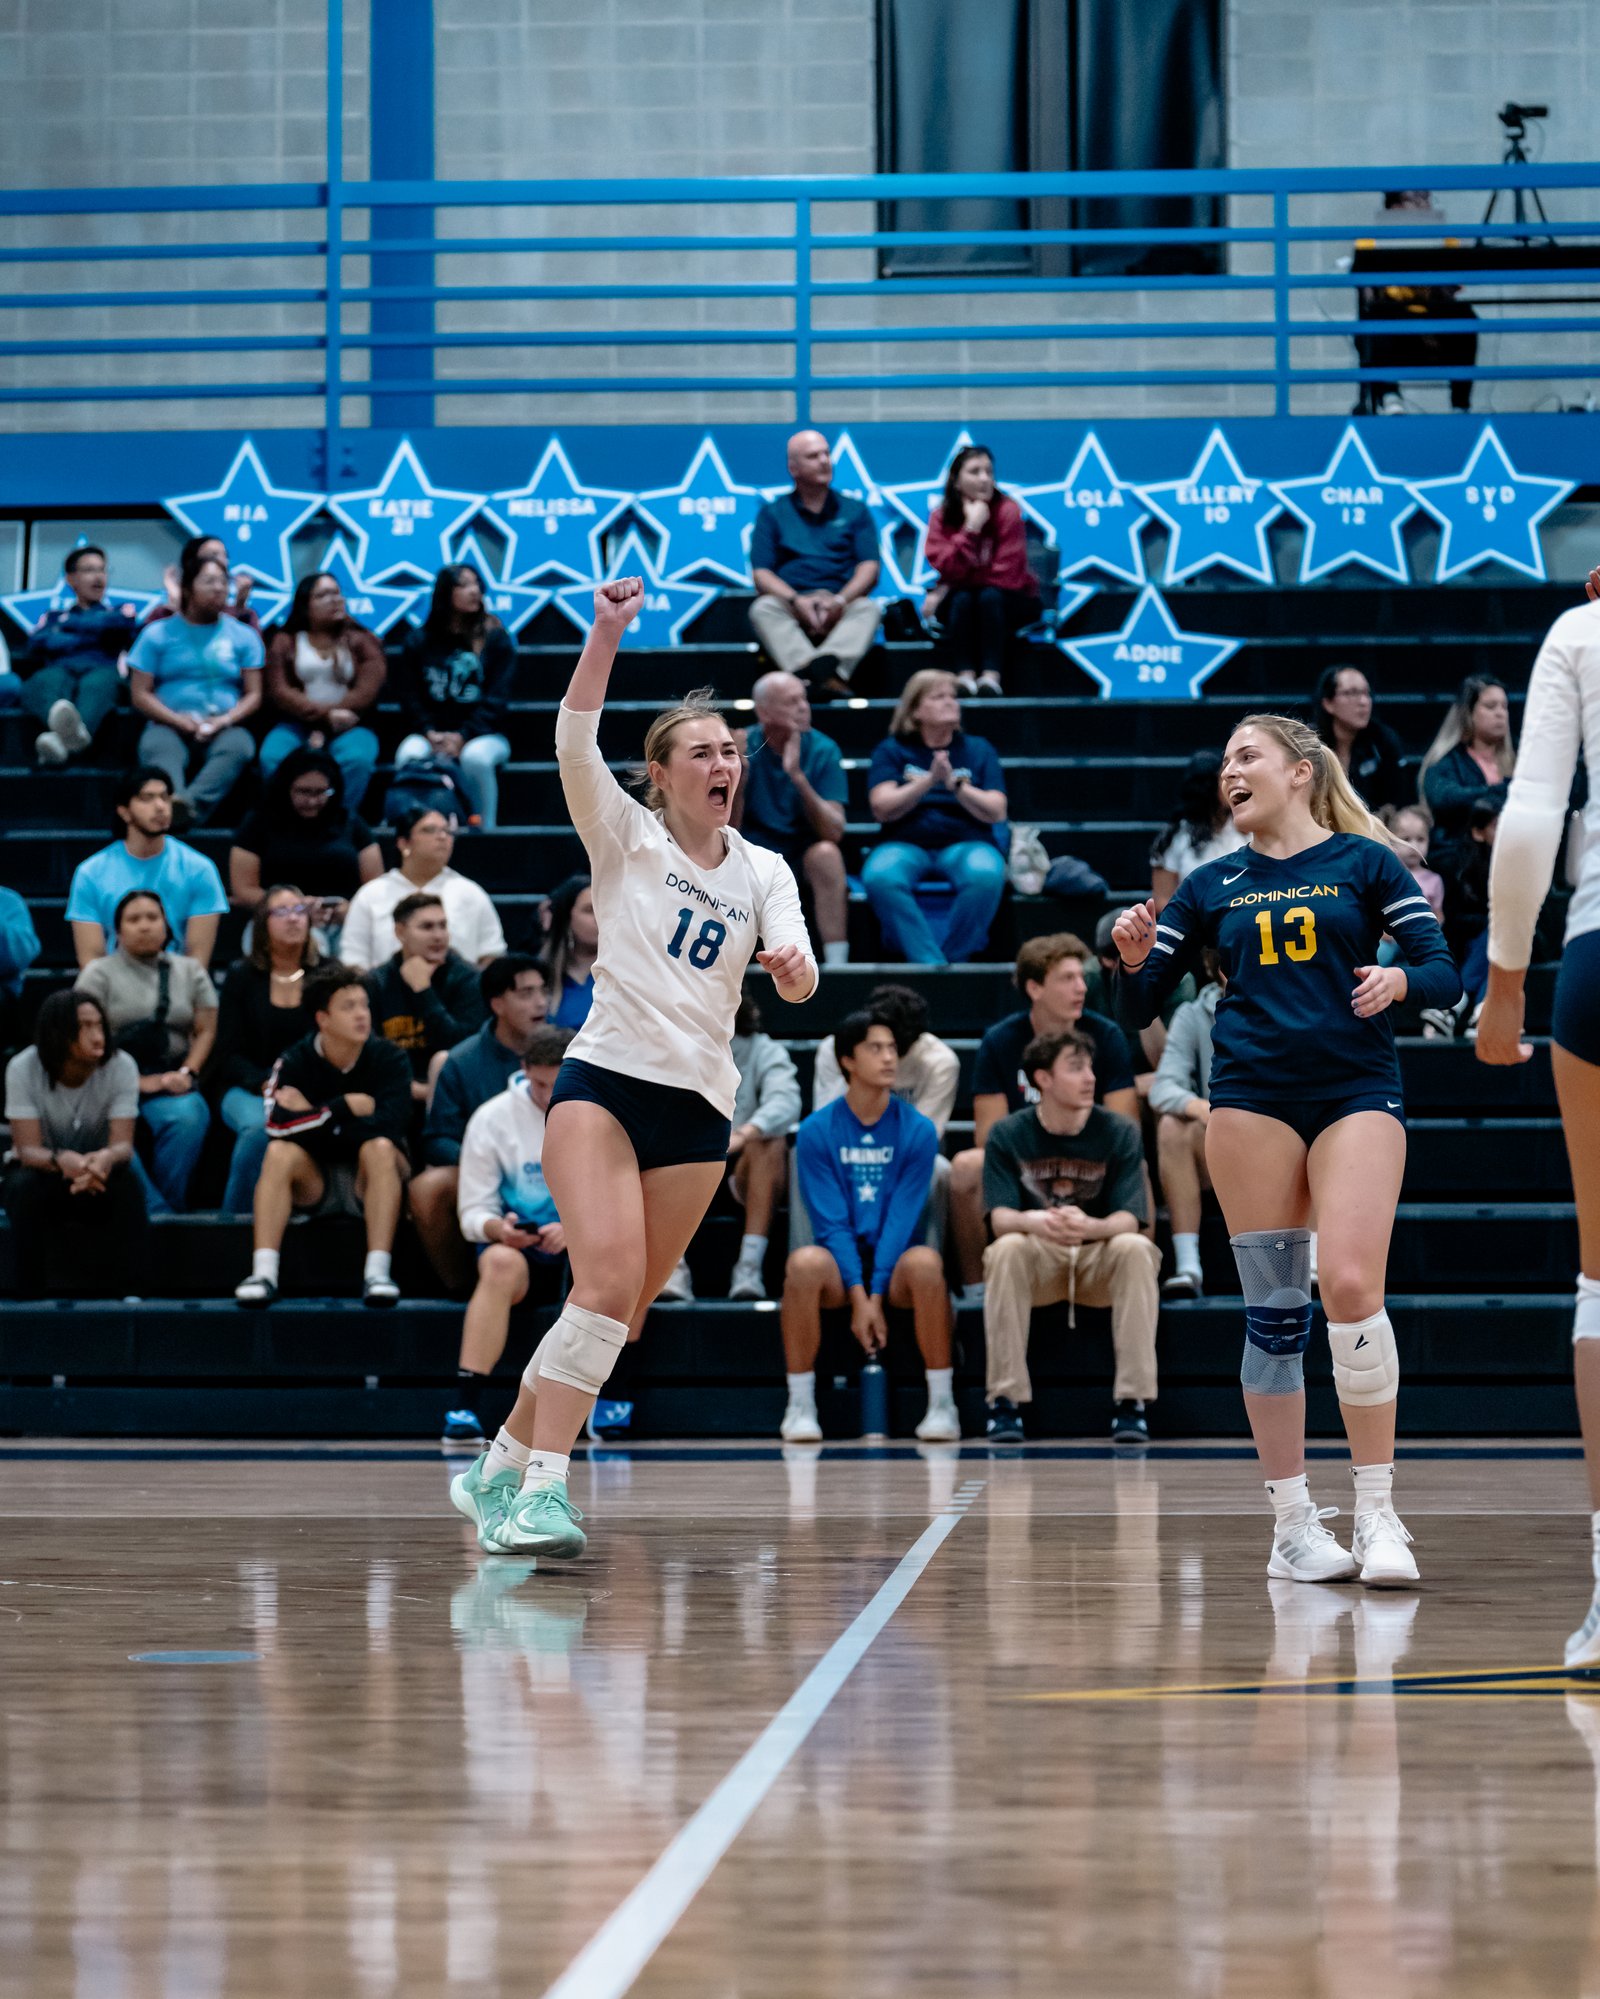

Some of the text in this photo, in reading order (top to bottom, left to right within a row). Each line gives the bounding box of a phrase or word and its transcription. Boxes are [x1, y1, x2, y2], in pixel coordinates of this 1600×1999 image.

[1063, 488, 1125, 508] LOLA
[1176, 485, 1258, 505] ELLERY
[1321, 486, 1384, 505] CHAR
[1465, 485, 1516, 505] SYD
[1204, 505, 1231, 524] 10
[1342, 506, 1366, 524] 12
[1113, 643, 1182, 665] ADDIE
[1137, 664, 1167, 684] 20
[1229, 884, 1339, 908] DOMINICAN
[667, 907, 727, 970] 18
[1255, 906, 1318, 966] 13
